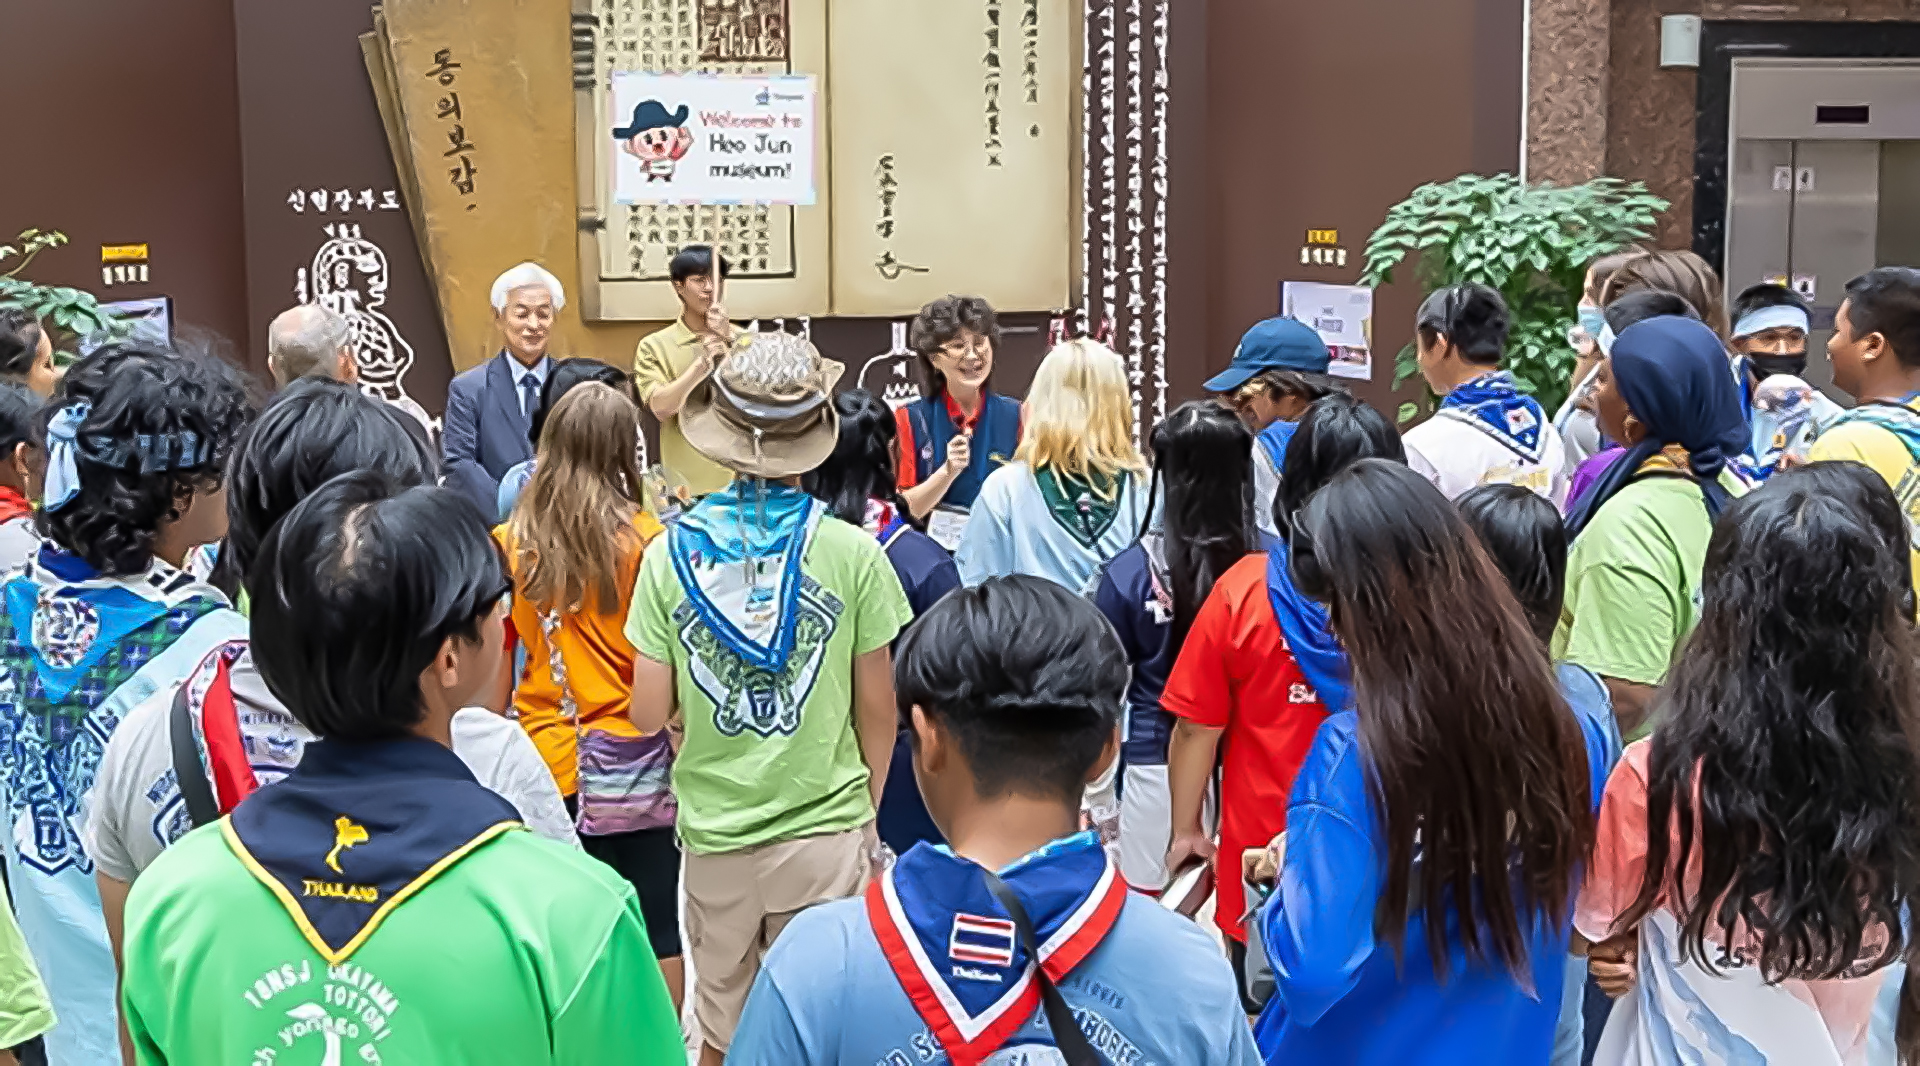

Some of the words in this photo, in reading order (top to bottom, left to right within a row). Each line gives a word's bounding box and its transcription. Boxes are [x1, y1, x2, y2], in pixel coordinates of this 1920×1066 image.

[425, 48, 477, 195] 동의보감
[710, 132, 747, 154] Heo
[754, 132, 792, 154] Jun
[709, 161, 792, 180] museum!
[302, 878, 379, 903] THAILAND
